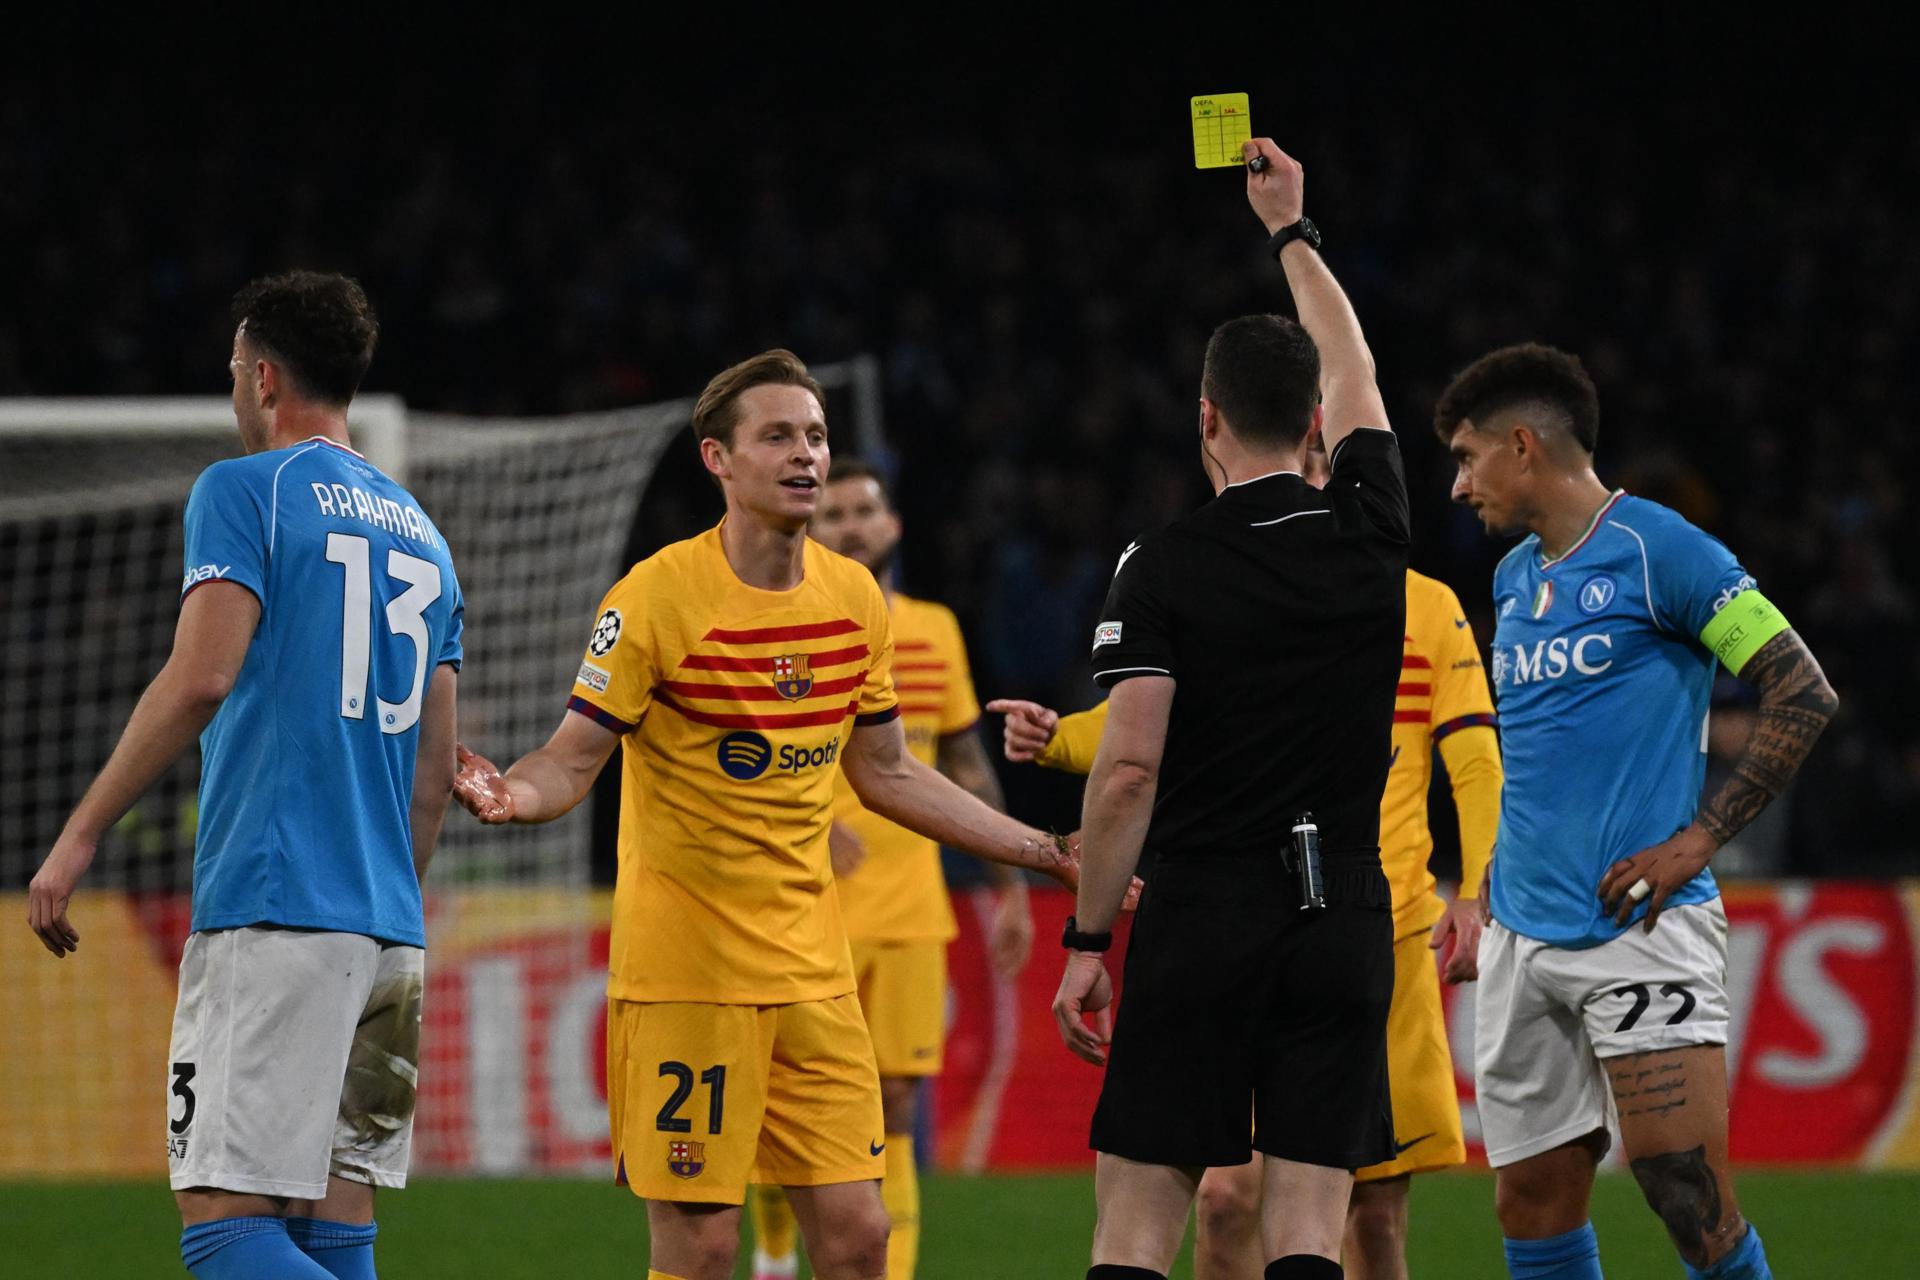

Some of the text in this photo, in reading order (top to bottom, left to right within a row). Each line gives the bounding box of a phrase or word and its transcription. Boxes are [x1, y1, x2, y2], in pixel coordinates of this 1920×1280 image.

[325, 532, 442, 735] 13
[1513, 633, 1613, 685] MSC
[1612, 983, 1697, 1033] 22
[170, 1062, 197, 1135] 3
[655, 1060, 727, 1135] 21
